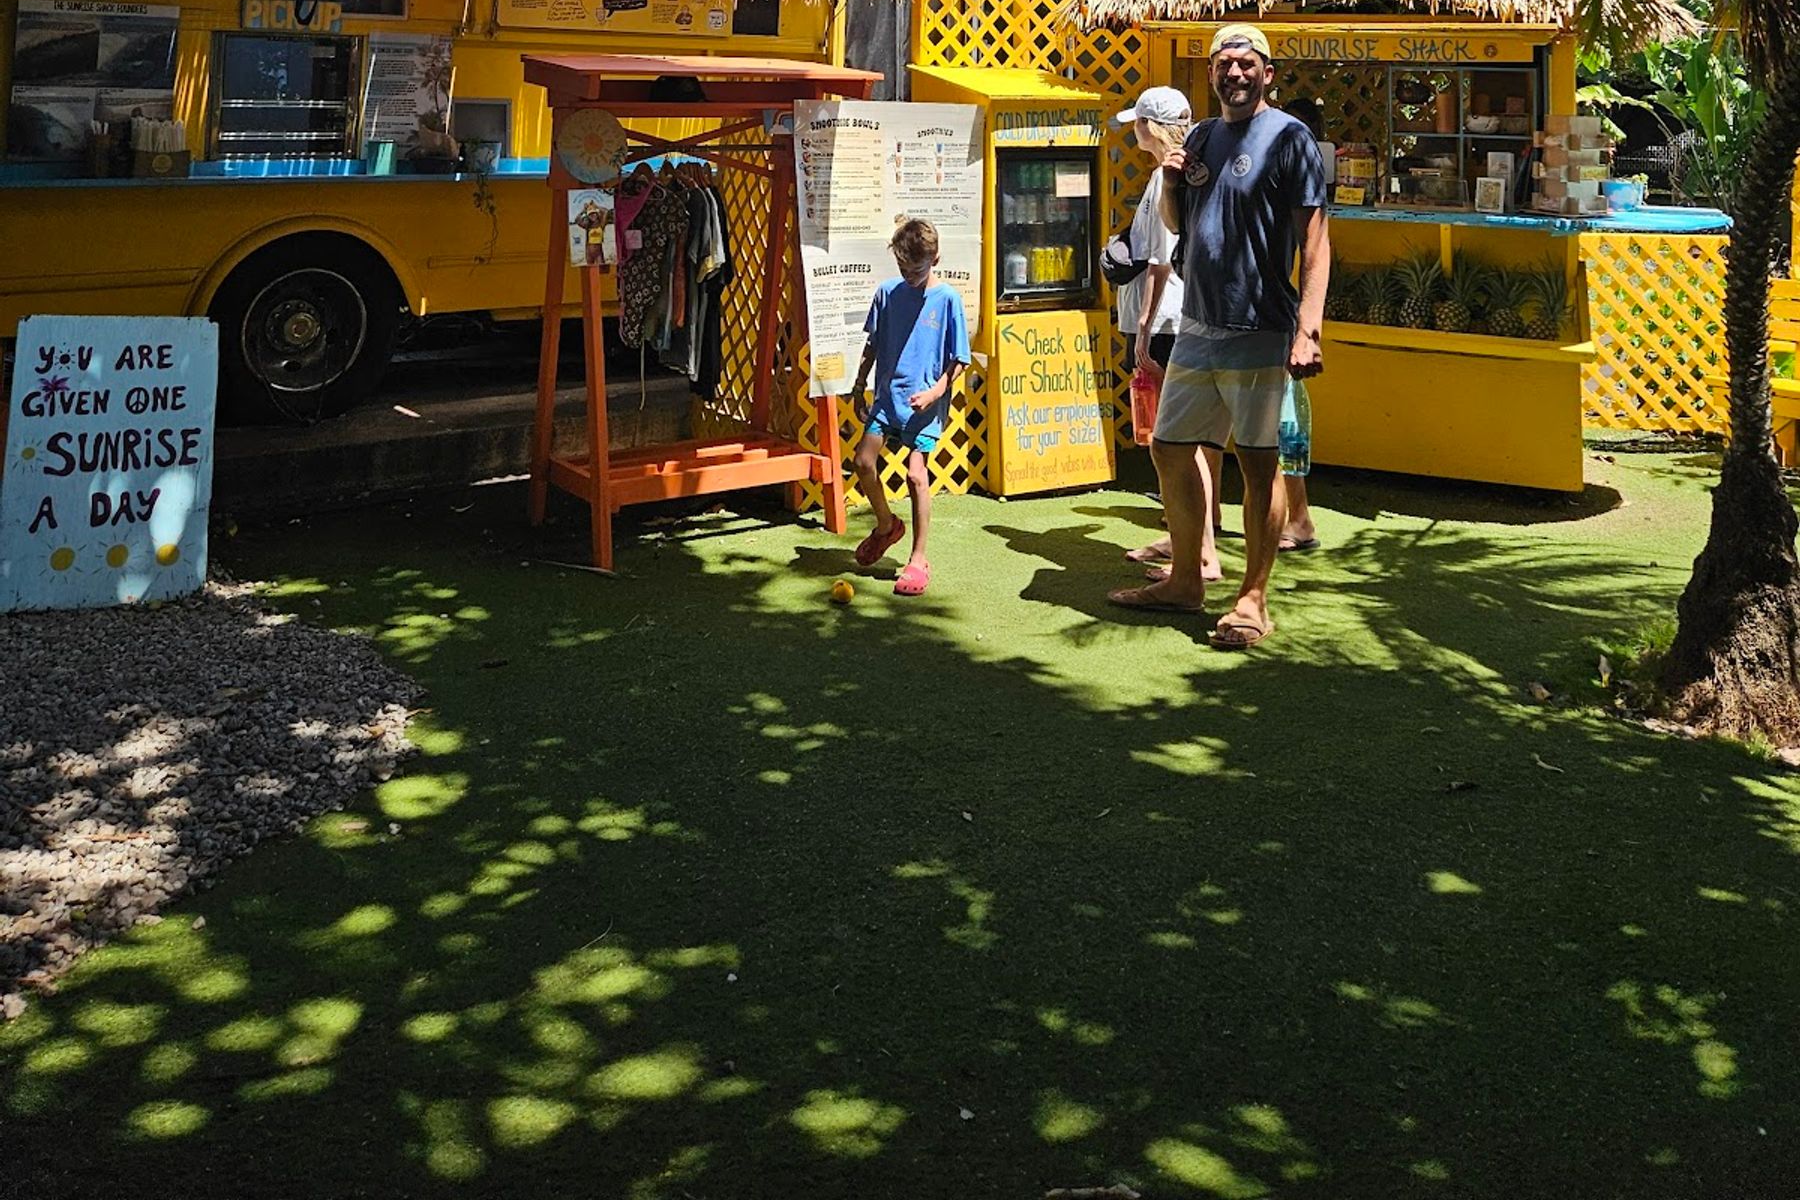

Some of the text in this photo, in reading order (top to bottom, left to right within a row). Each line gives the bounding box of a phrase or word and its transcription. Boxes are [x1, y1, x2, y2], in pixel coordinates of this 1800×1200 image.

[54, 0, 65, 10] THE
[66, 1, 94, 11] SUNRISE
[1276, 36, 1476, 62] SUNRISE SHACK
[810, 117, 880, 132] SMOOTHIE BOWLS
[995, 110, 1024, 141] COLD
[813, 263, 872, 278] BULLET COFFEES
[1024, 326, 1101, 356] Check out
[115, 344, 174, 371] ARE
[1002, 357, 1113, 398] our Shack Merch
[21, 385, 187, 417] GIVEN ONE
[1006, 397, 1113, 428] Ask our employees
[1016, 420, 1102, 457] for your size!
[28, 487, 161, 534] A DAY
